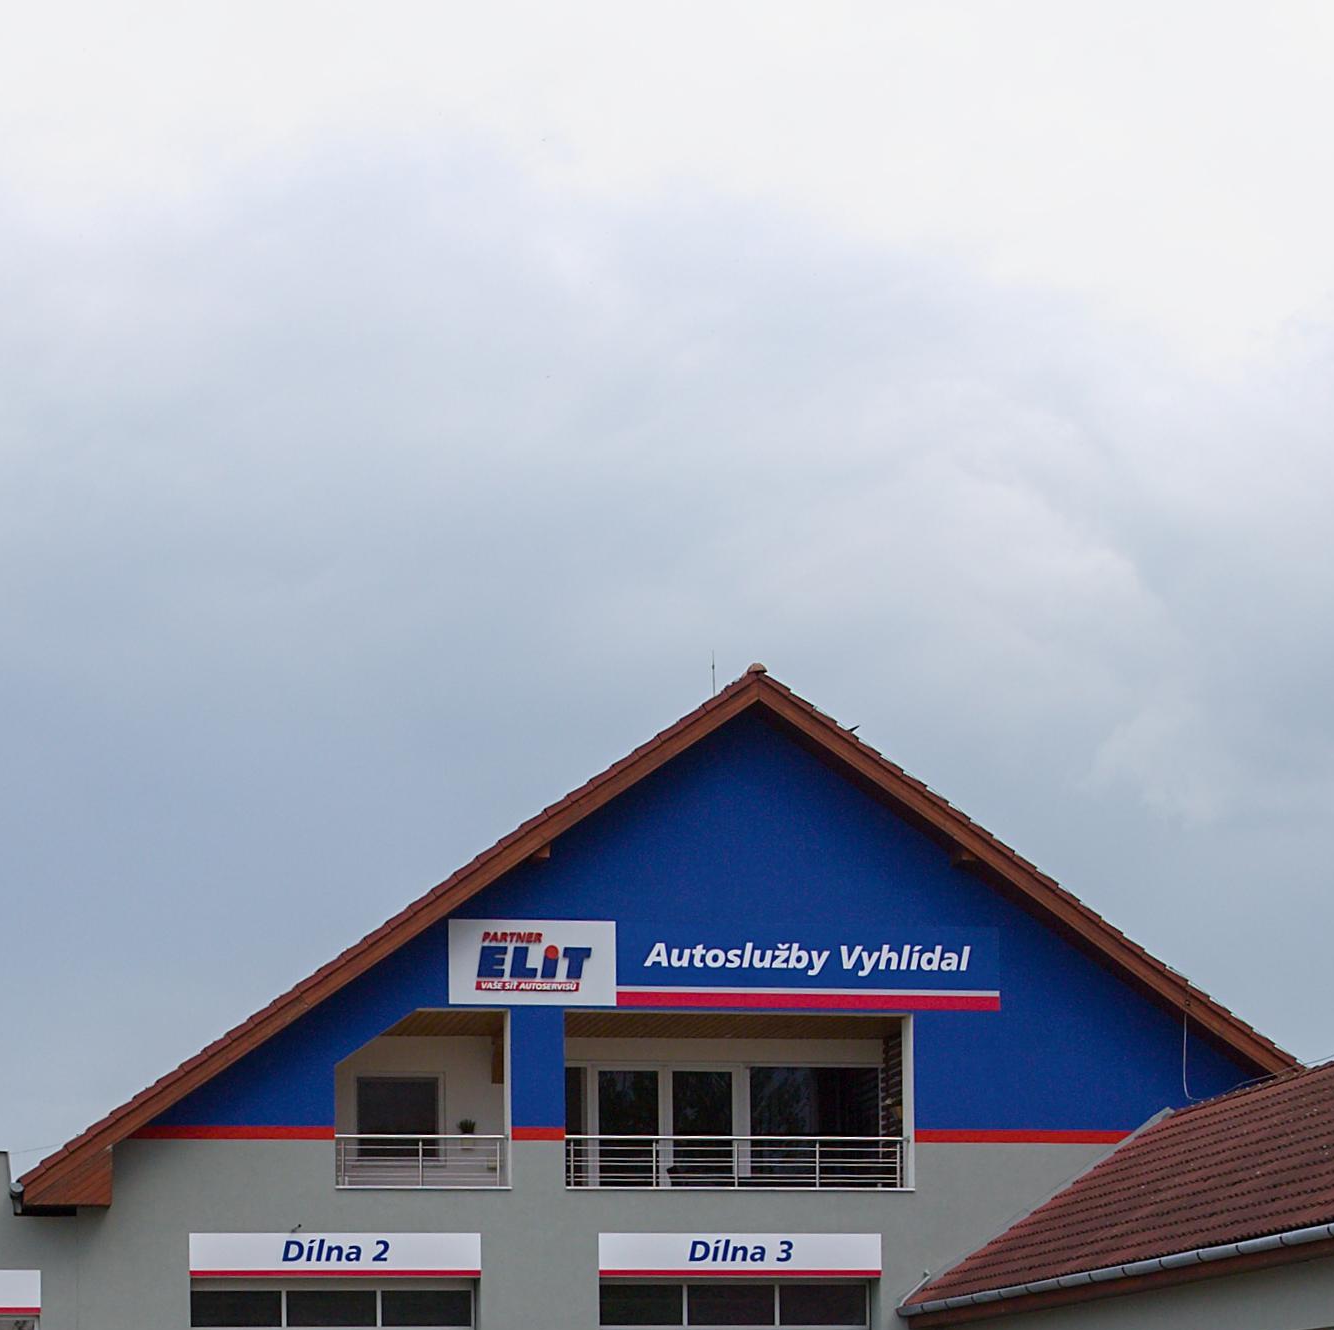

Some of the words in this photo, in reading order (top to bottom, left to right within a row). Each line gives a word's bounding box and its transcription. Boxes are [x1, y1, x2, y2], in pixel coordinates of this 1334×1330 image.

[482, 931, 543, 943] PARTNER
[644, 942, 830, 976] Autoslužby
[839, 945, 971, 976] Vyhlídal
[282, 1239, 362, 1262] Dílna
[372, 1239, 390, 1262] 2
[688, 1239, 766, 1262] Dílna
[776, 1240, 793, 1262] 3
